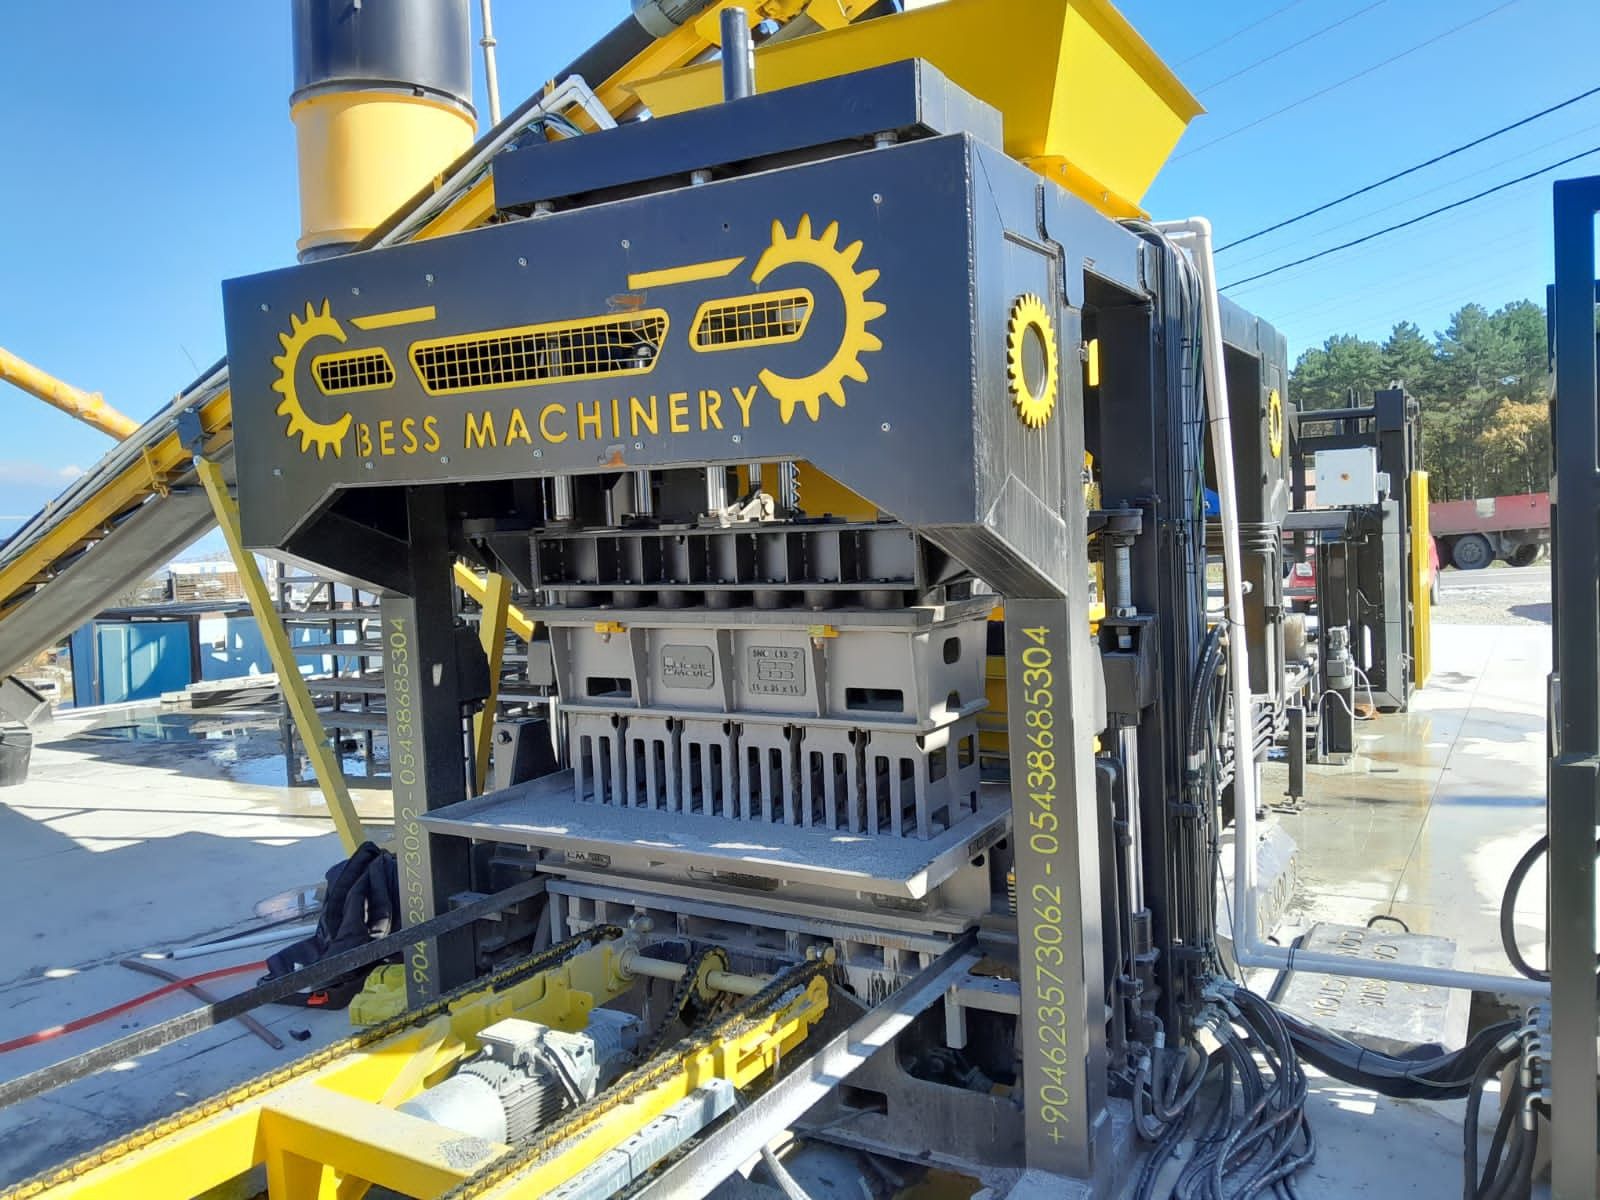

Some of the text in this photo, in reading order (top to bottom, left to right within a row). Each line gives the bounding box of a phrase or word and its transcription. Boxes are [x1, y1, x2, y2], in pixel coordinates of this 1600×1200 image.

[354, 385, 758, 457] BESS MACHINERY
[390, 618, 417, 785] 05438685304
[1022, 625, 1059, 855] 05438685304
[402, 807, 430, 999] +90423573062
[1032, 884, 1069, 1145] +904623573062
